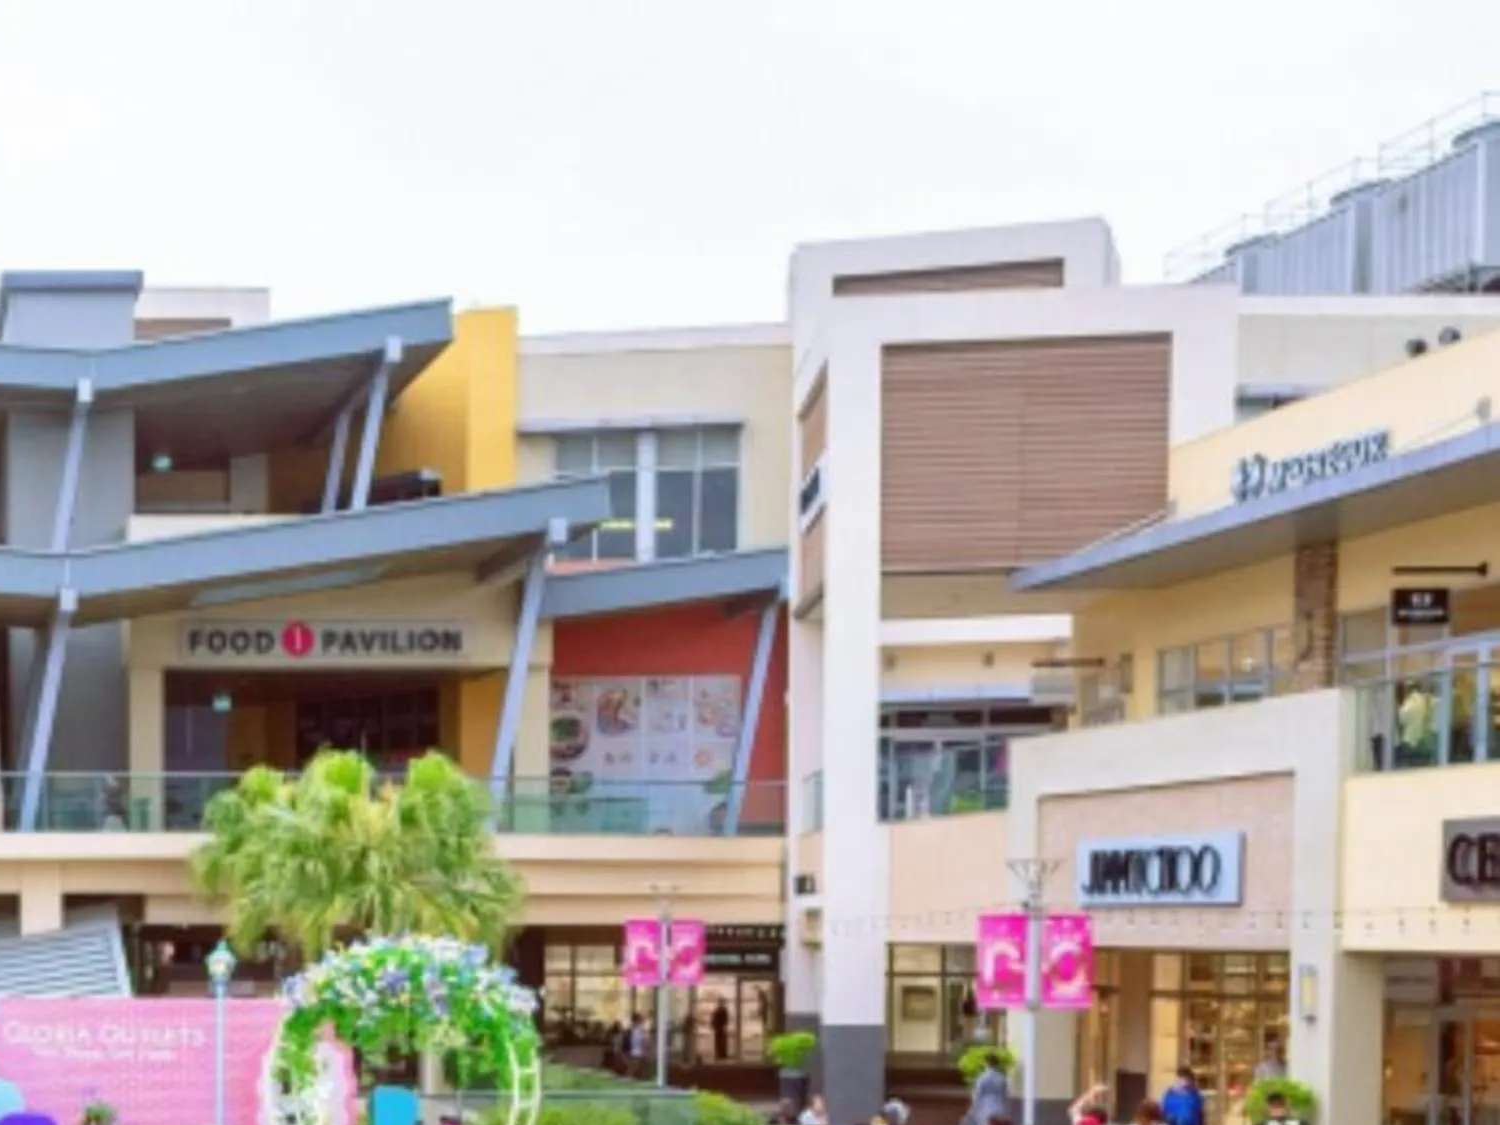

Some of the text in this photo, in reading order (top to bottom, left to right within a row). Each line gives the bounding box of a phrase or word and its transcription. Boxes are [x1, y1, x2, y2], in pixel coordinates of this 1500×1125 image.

[189, 629, 276, 654] FOOD
[321, 629, 463, 654] PAVILION
[3, 1020, 90, 1044] GLORIA
